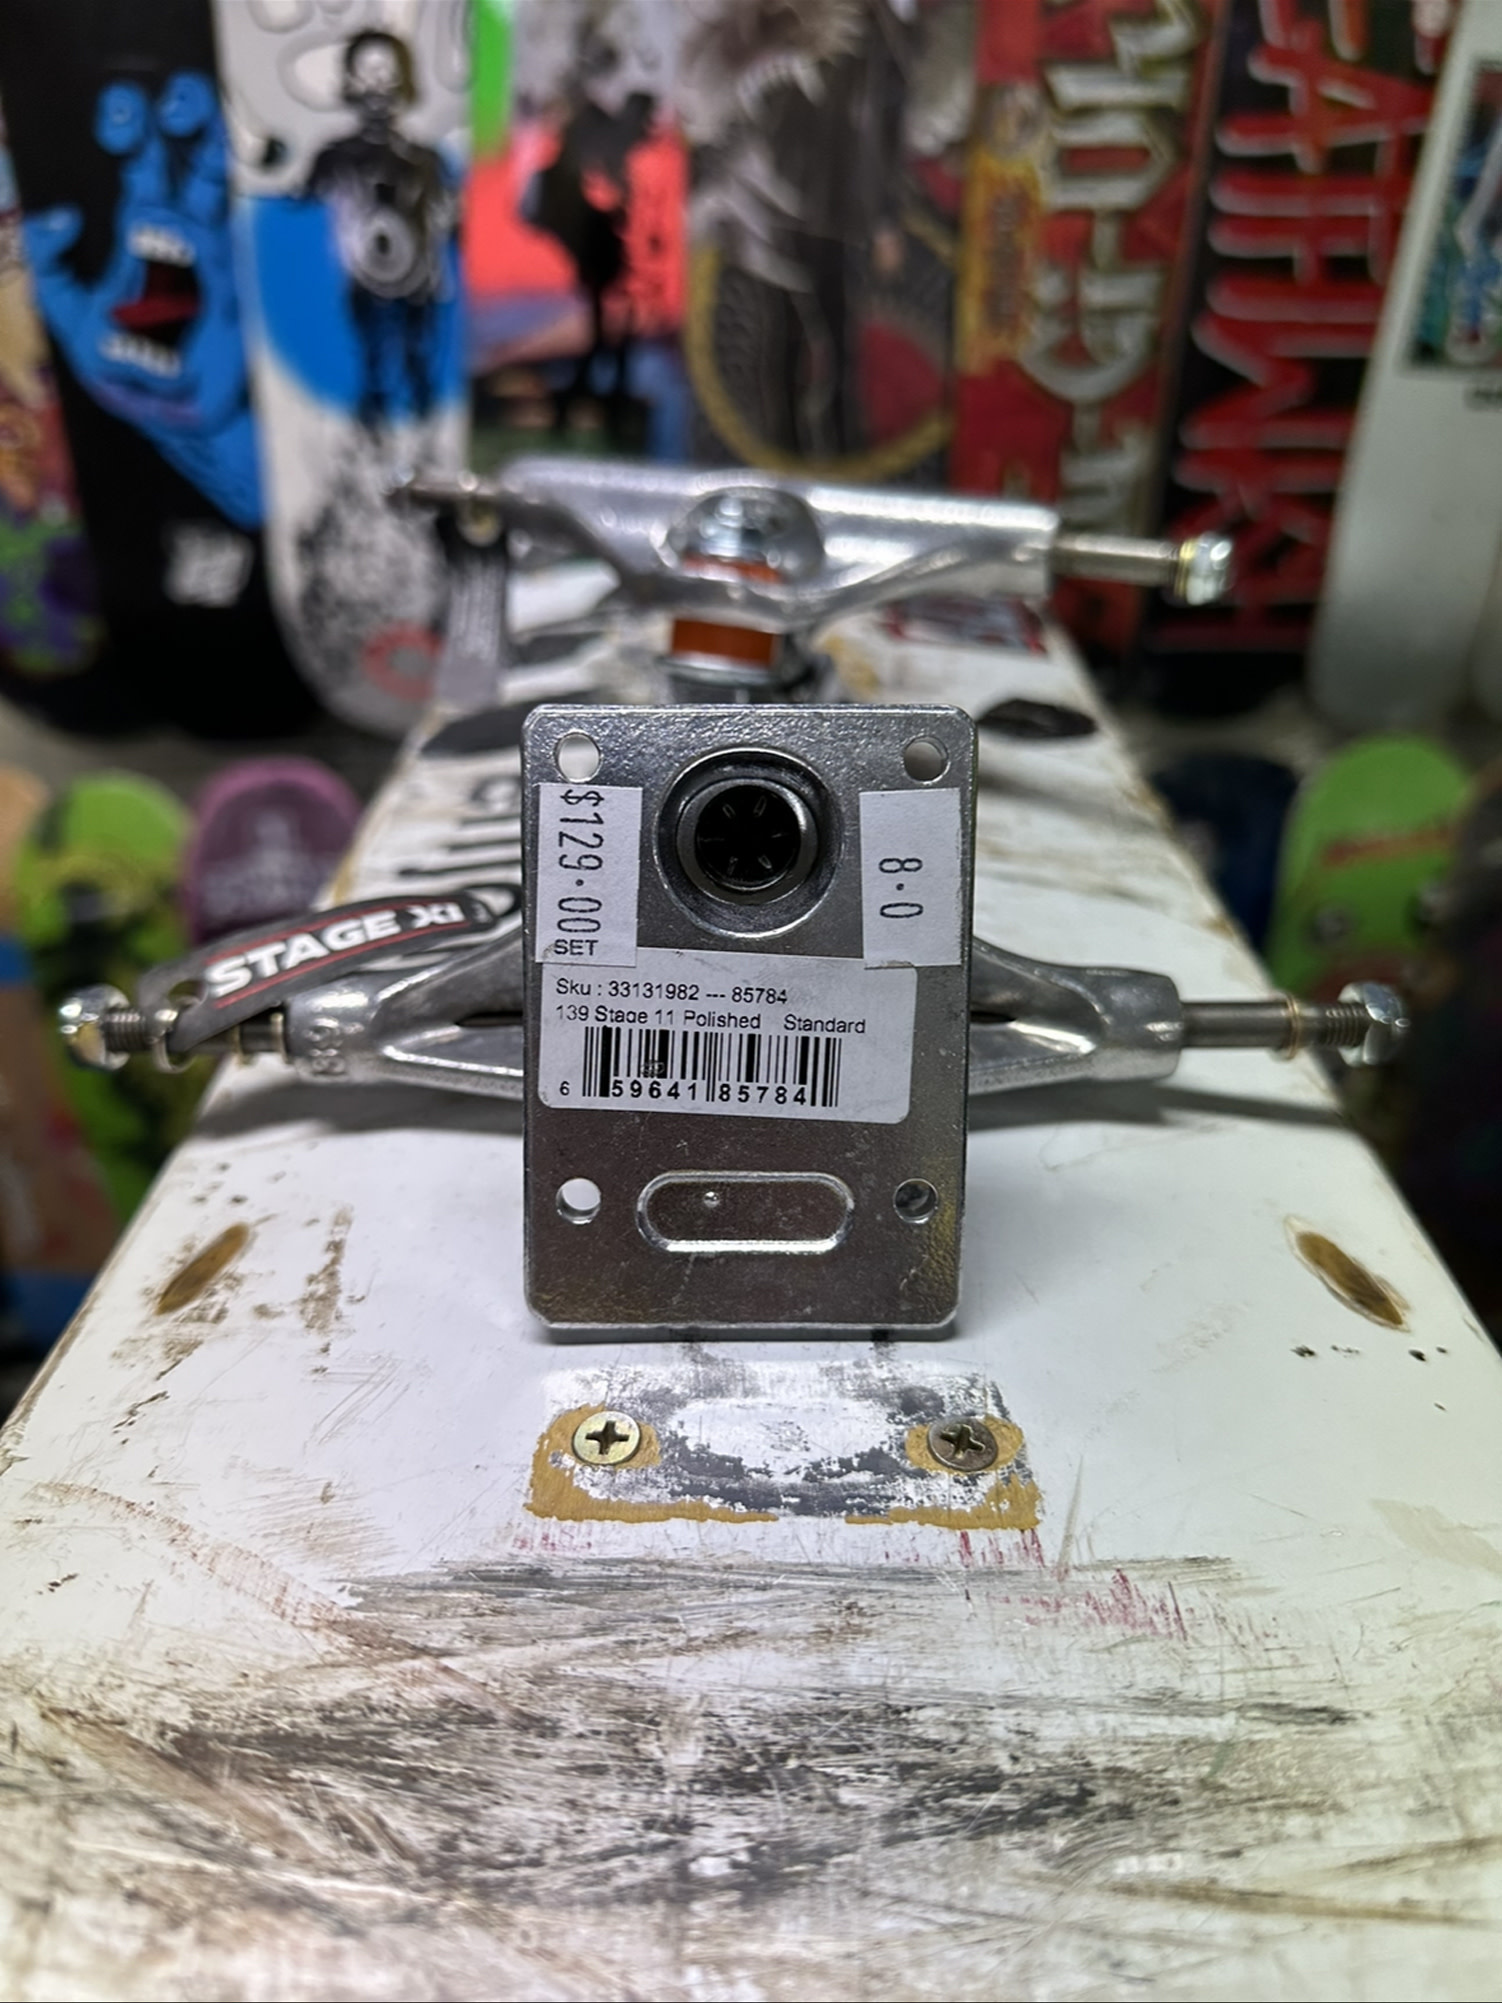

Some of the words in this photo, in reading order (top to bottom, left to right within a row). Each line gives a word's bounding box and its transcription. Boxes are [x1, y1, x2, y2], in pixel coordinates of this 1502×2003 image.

[557, 789, 604, 933] $129.00
[878, 857, 923, 918] 8.0
[205, 910, 401, 998] STAGE
[554, 939, 598, 956] SET
[556, 978, 591, 996] Sku
[608, 980, 699, 1000] 33131982
[731, 986, 788, 1004] 85784
[556, 1004, 589, 1021] 139
[655, 1009, 674, 1025] 11
[683, 1009, 761, 1029] Polished
[783, 1013, 866, 1034] Standard
[559, 1081, 570, 1096] 6
[611, 1079, 697, 1100] 59641
[718, 1083, 807, 1105] 85784
